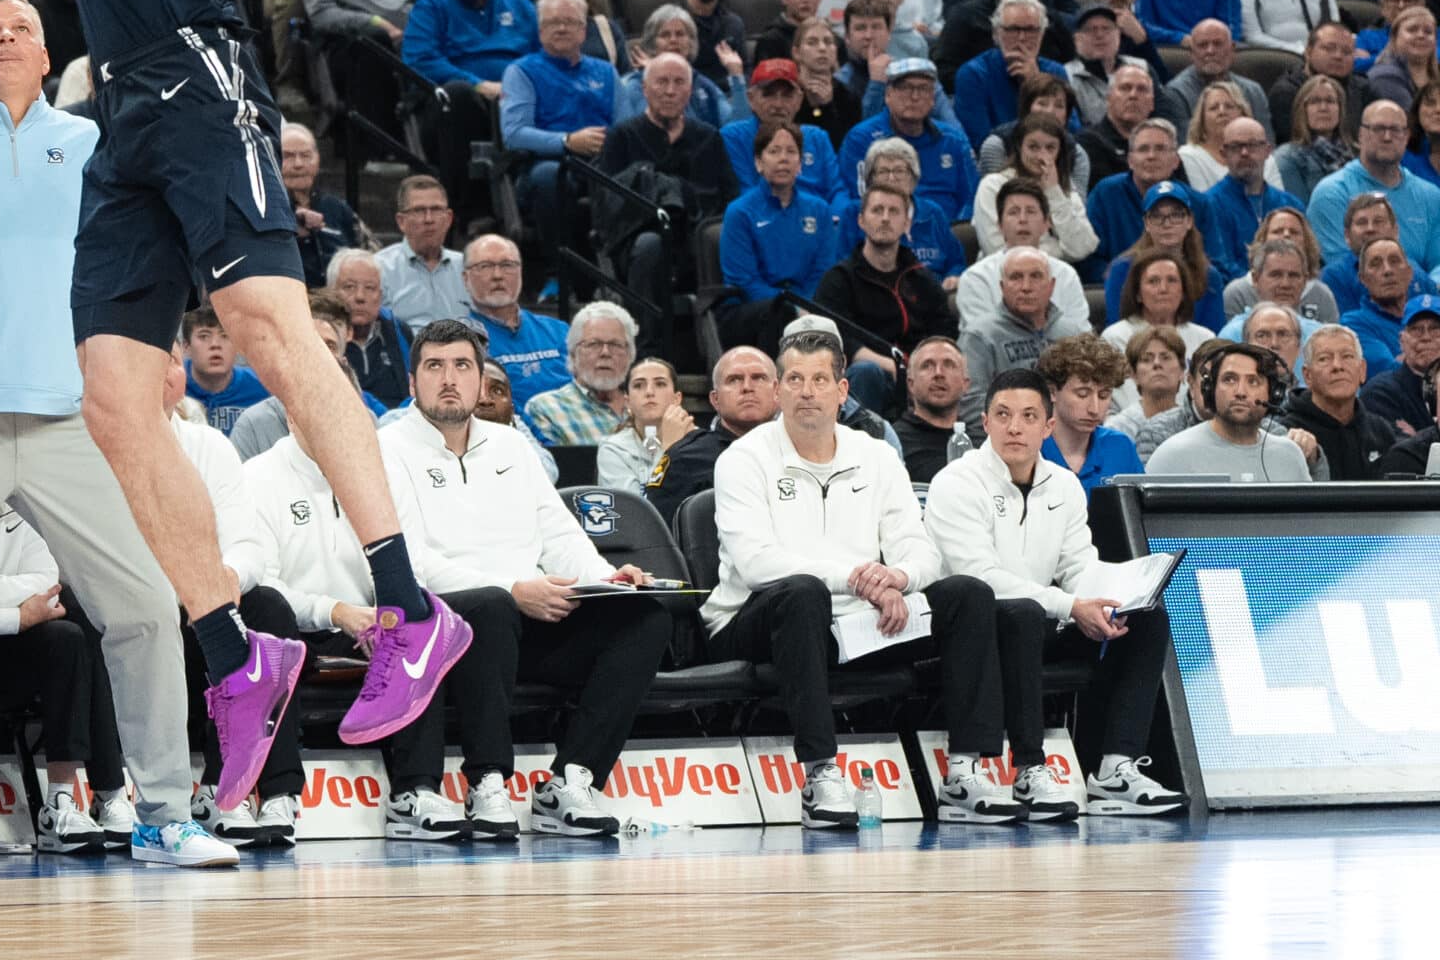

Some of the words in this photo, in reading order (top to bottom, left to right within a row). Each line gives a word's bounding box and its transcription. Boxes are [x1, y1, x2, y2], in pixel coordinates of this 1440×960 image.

[1005, 340, 1043, 363] CREIG
[294, 768, 381, 819] Vee
[758, 752, 901, 794] Hee
